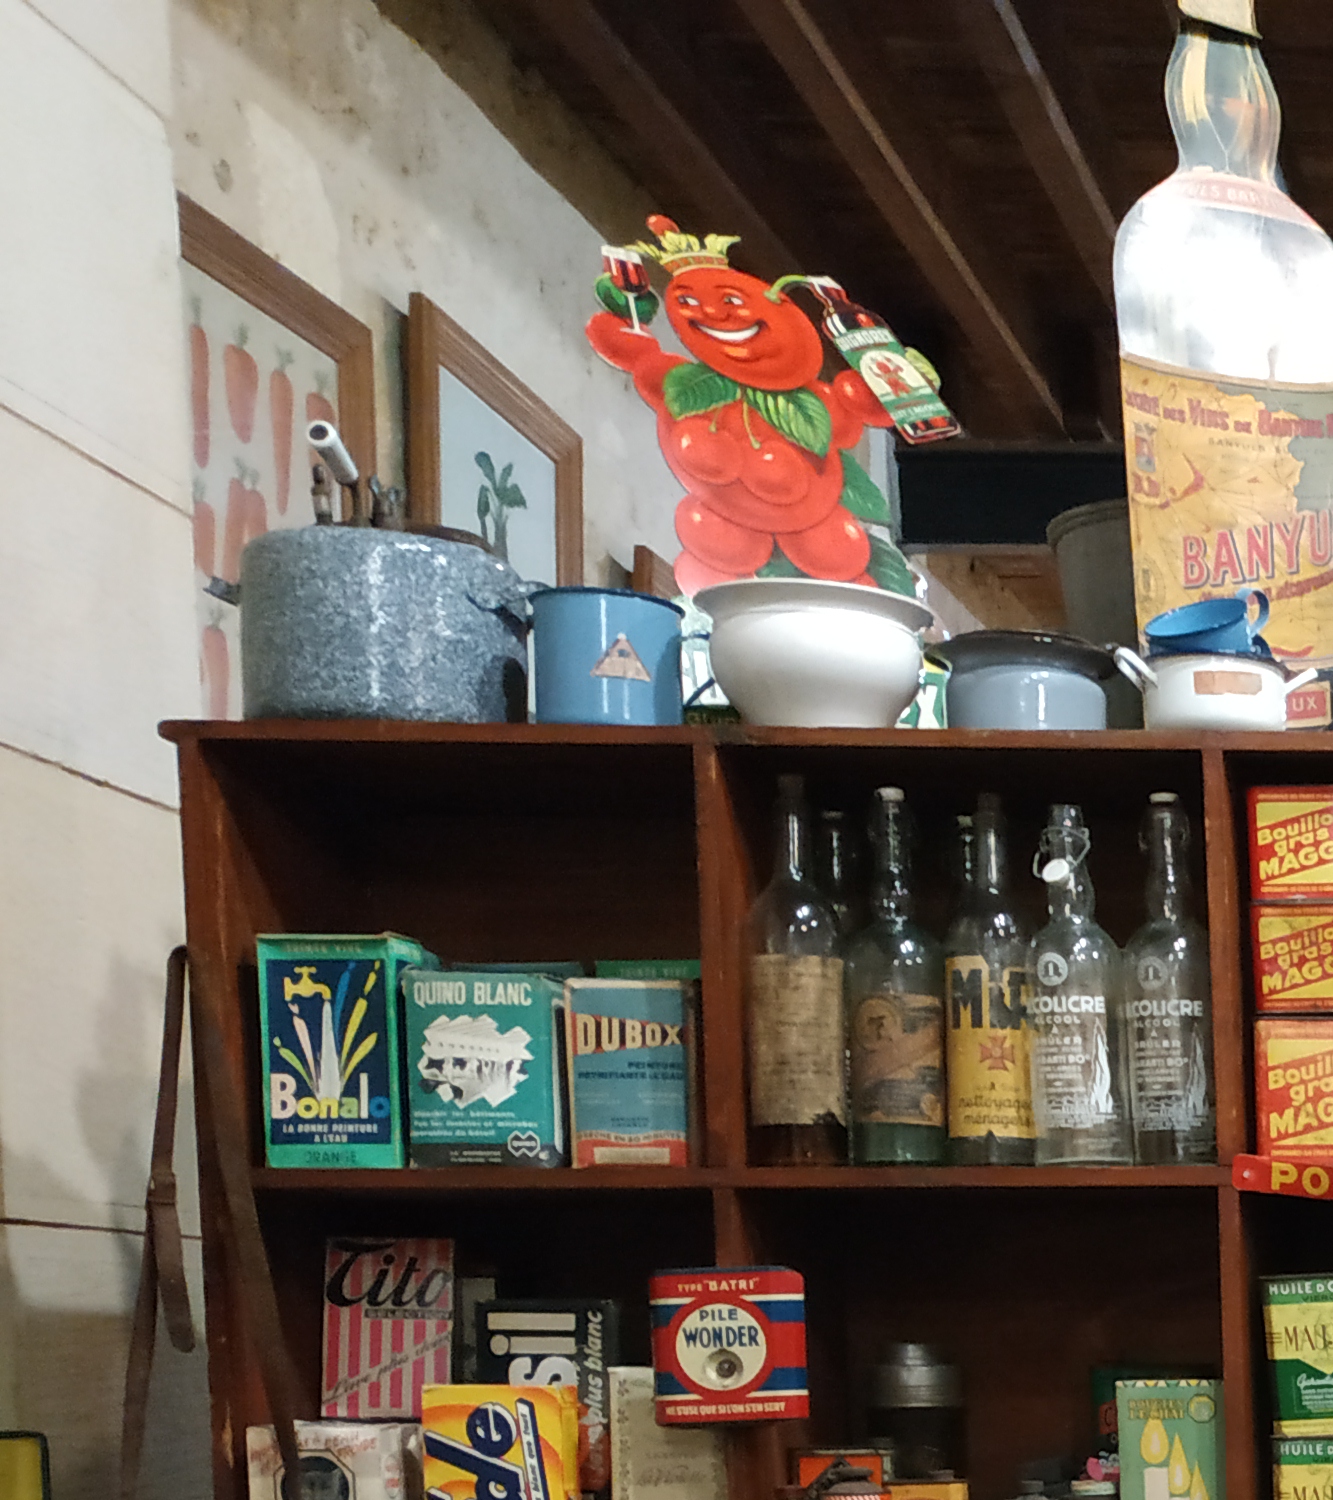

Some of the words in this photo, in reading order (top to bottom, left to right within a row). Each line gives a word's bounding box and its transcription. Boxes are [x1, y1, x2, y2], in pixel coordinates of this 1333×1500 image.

[1274, 826, 1330, 856] gras
[1278, 941, 1333, 968] gras
[414, 981, 467, 1006] QUINO
[473, 981, 532, 1006] BLANC
[577, 1014, 682, 1054] DUBOX
[270, 1073, 390, 1119] Bonalo
[1269, 1281, 1312, 1295] HUILE
[700, 1309, 738, 1321] PILE
[682, 1326, 760, 1348] WONDER
